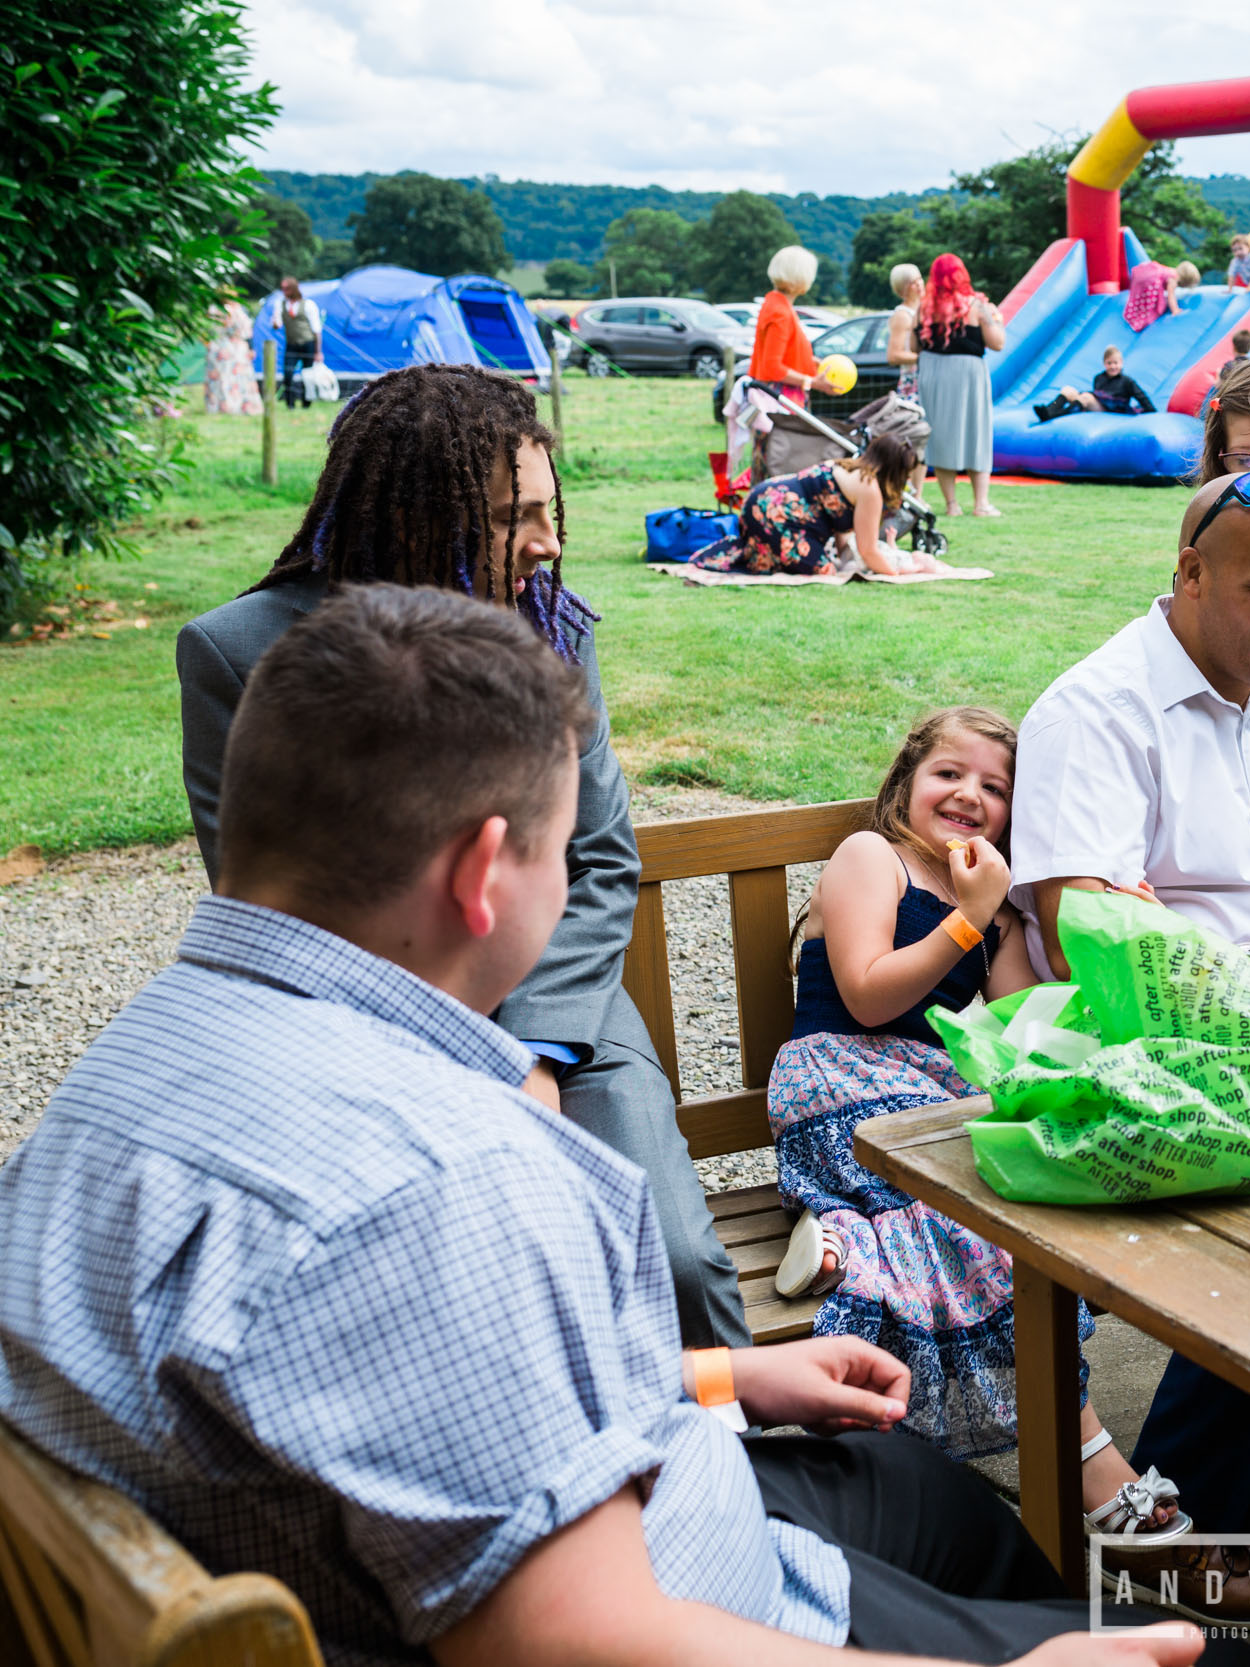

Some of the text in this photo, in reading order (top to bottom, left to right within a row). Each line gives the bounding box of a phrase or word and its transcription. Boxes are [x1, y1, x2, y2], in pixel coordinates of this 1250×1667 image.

[1168, 939, 1187, 977] after
[1138, 935, 1163, 1022] after shop,
[1199, 986, 1215, 1024] after
[1196, 1048, 1233, 1066] after
[1168, 1108, 1210, 1126] shop,
[1111, 1120, 1147, 1149] shop,
[1150, 1138, 1187, 1164] AFTER
[1185, 1129, 1223, 1152] shop,
[1075, 1149, 1114, 1172] after
[1098, 1137, 1138, 1165] after
[1136, 1157, 1178, 1183] shop,
